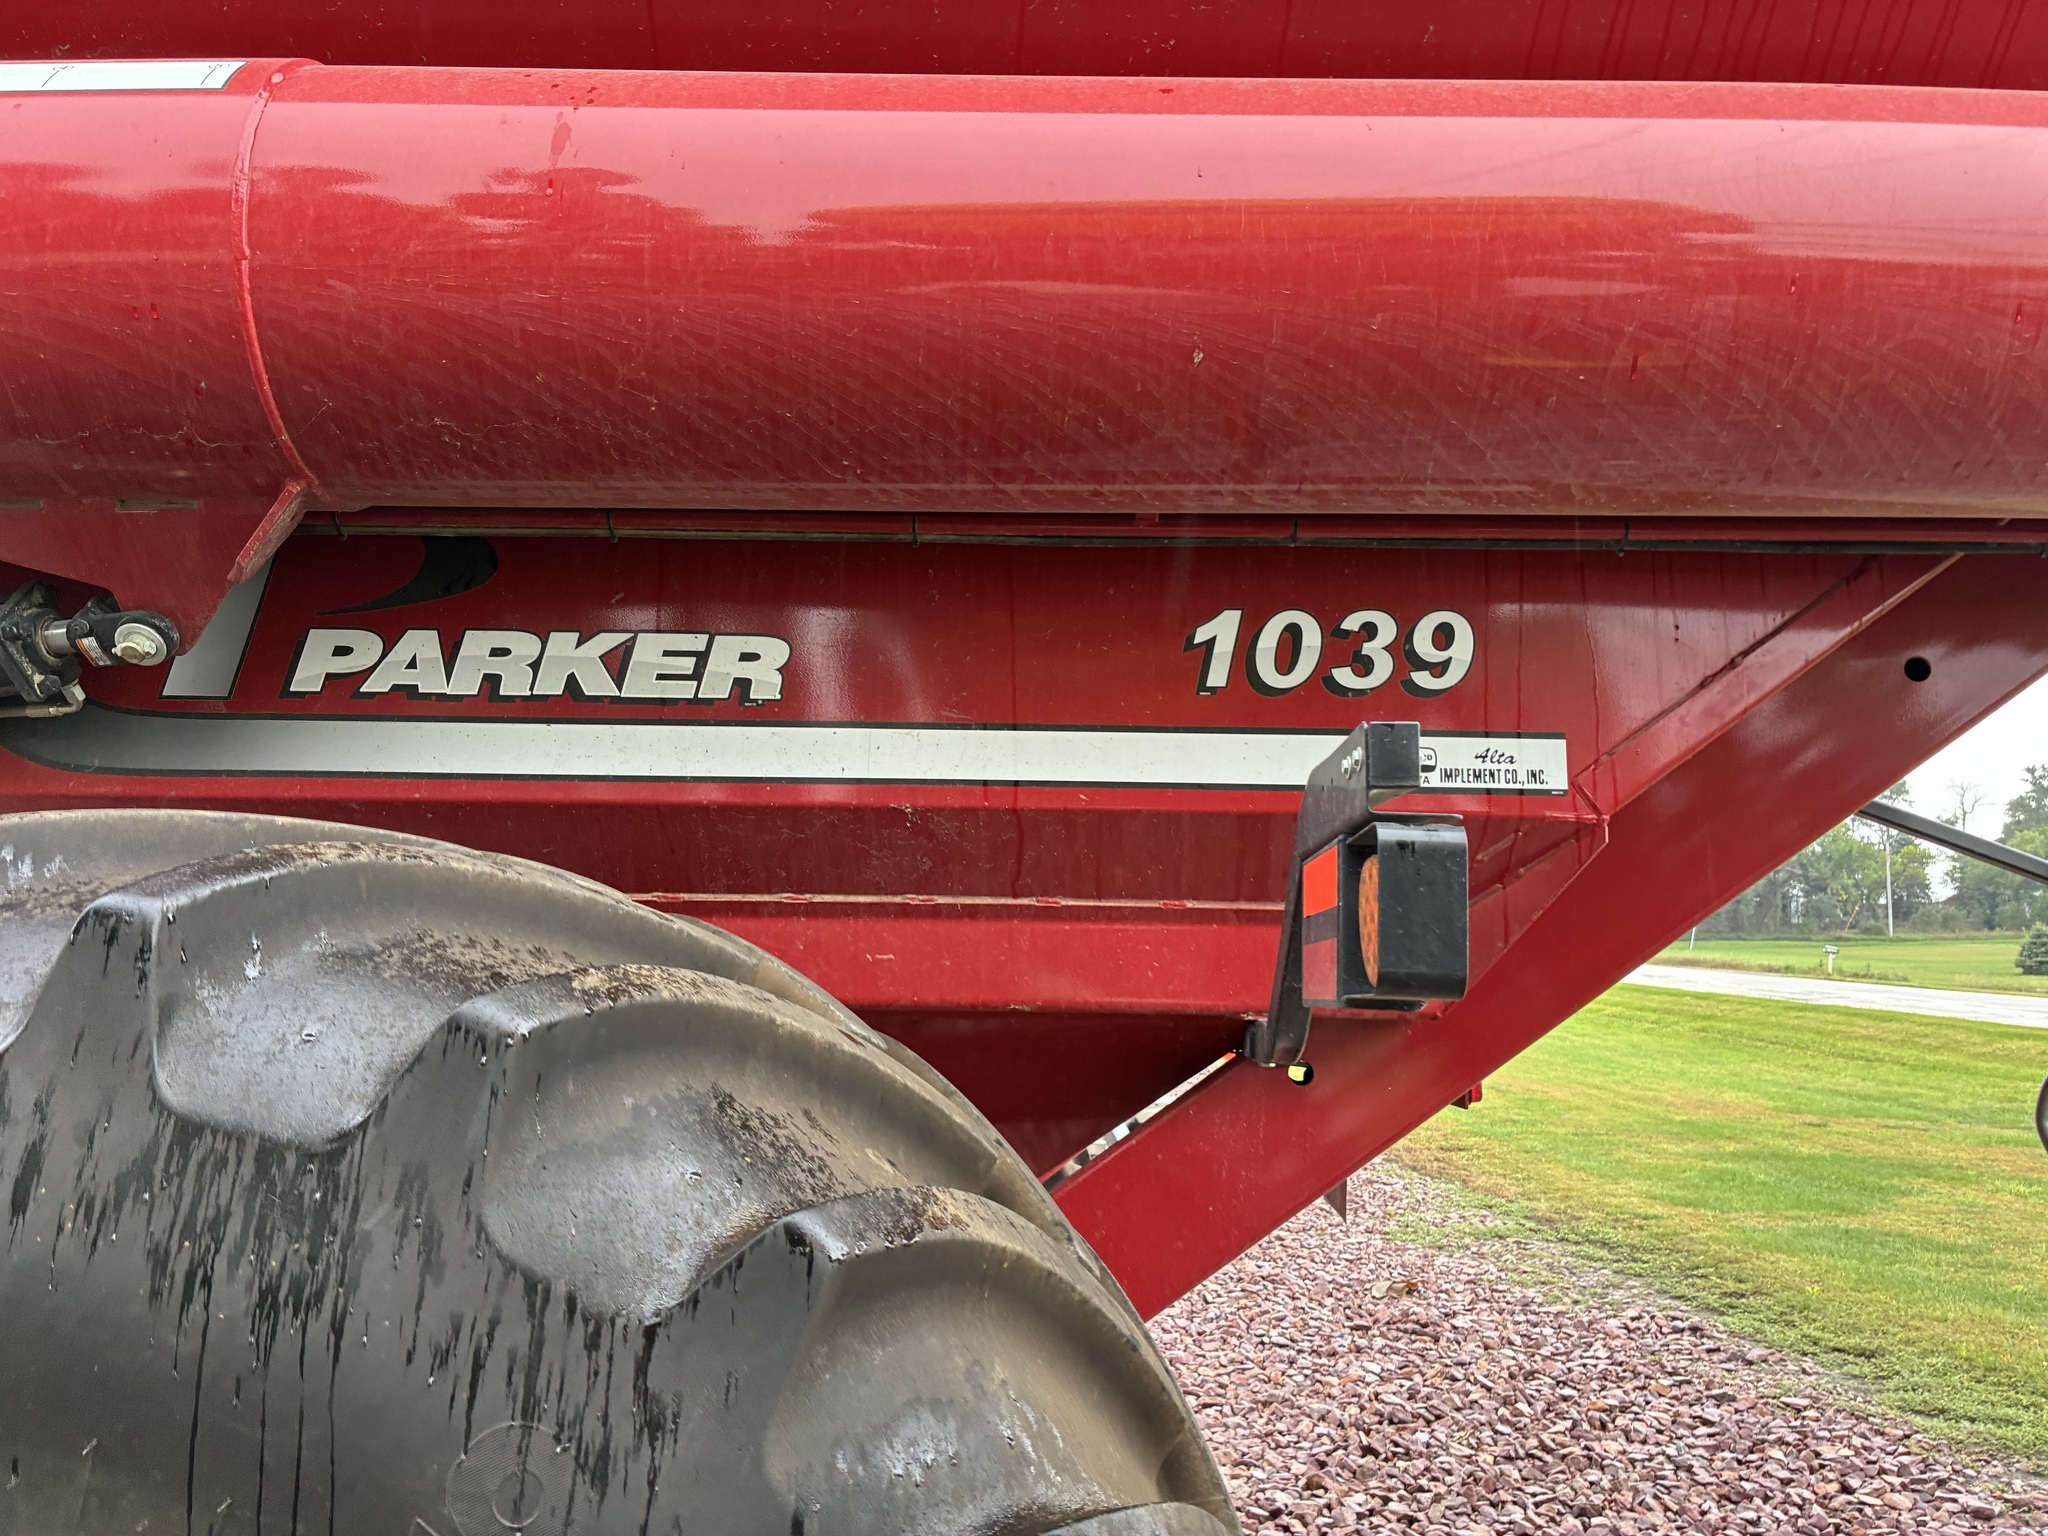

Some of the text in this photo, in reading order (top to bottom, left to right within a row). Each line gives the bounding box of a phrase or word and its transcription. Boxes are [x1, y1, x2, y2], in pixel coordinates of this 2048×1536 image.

[283, 627, 791, 703] PARKER
[1187, 608, 1475, 694] 1039
[1439, 767, 1502, 785] IMPLEMENT
[1526, 768, 1549, 786] INC.
[1473, 747, 1517, 765] Alta
